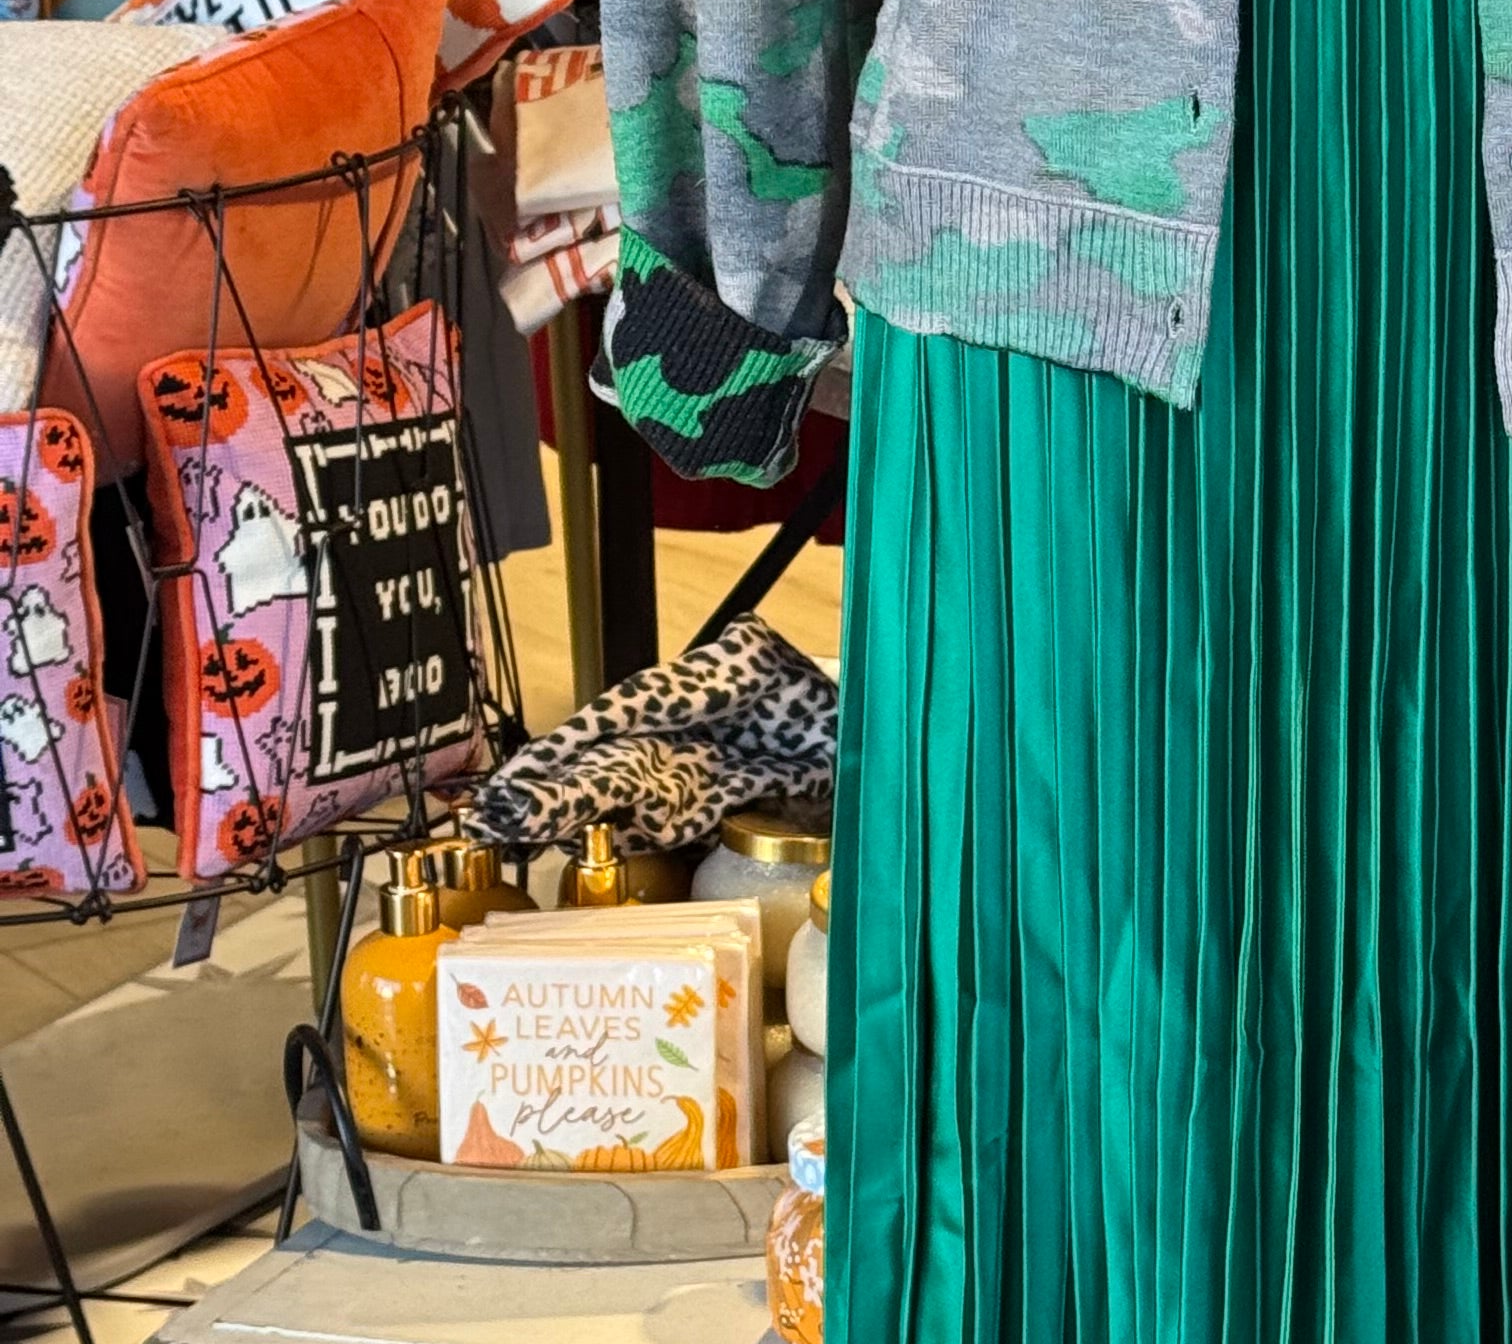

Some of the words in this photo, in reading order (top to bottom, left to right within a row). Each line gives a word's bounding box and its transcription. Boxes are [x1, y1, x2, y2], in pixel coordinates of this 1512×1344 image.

[412, 484, 451, 531] DO
[502, 983, 653, 1009] AUTUMN
[516, 1015, 640, 1041] LEAVES
[545, 1031, 609, 1066] and
[491, 1063, 664, 1097] PUMPKINS
[510, 1087, 645, 1137] please
